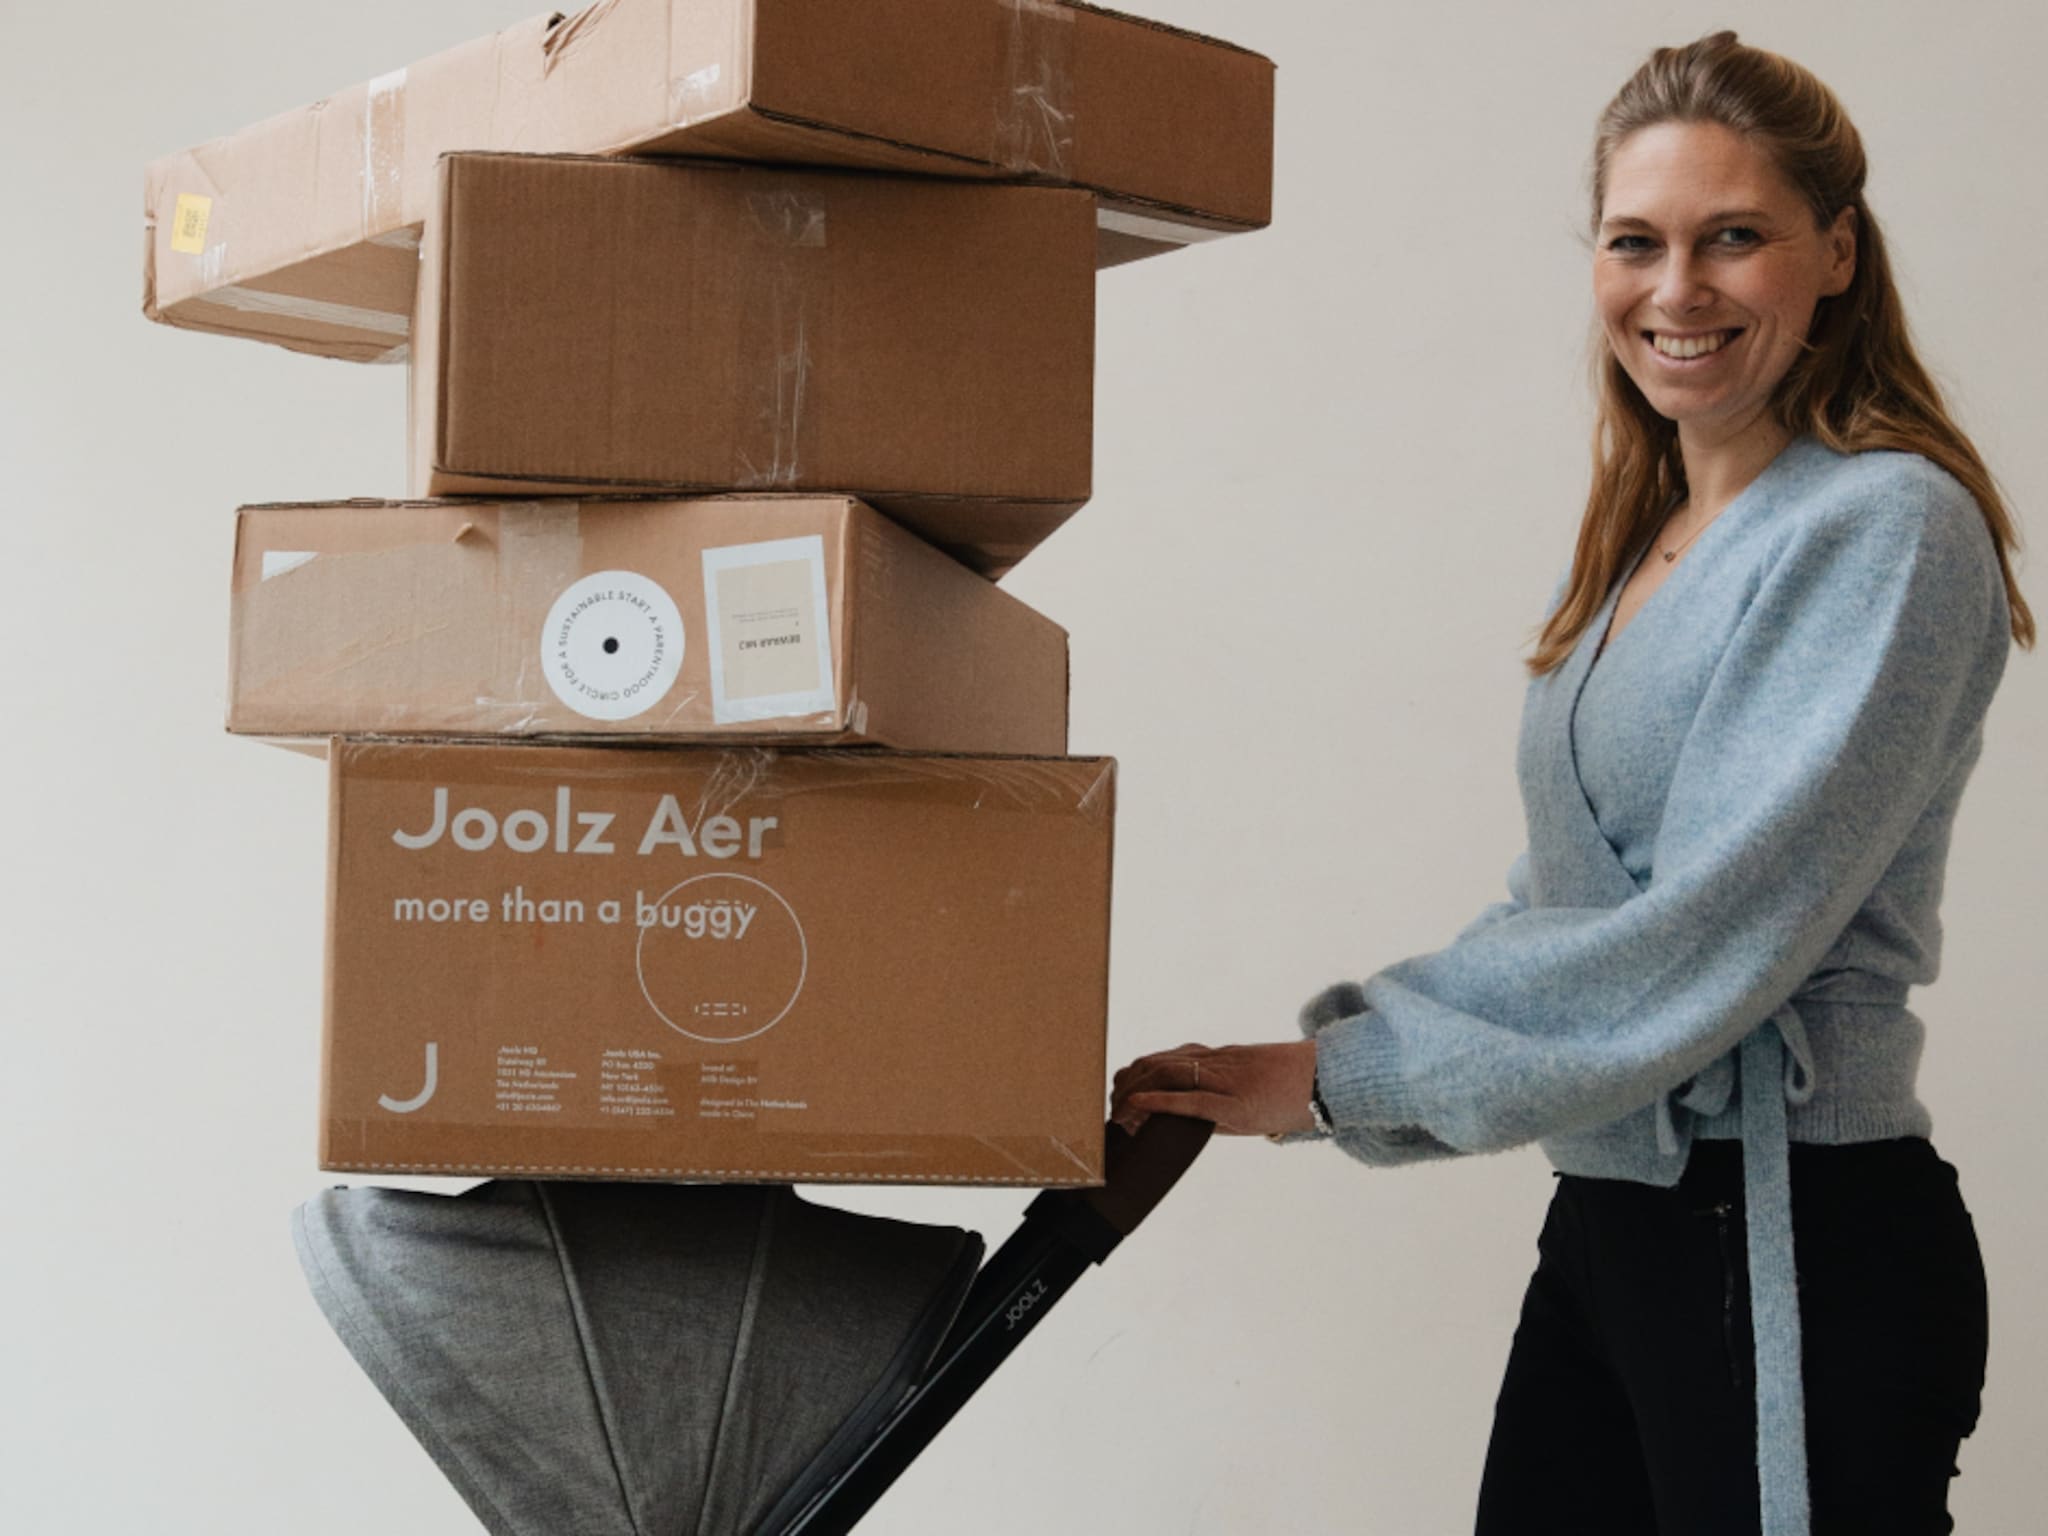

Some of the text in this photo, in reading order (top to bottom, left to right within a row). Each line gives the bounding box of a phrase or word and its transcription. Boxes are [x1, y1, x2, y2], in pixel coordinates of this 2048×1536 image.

[558, 590, 614, 647] SUSTAINABLE
[618, 591, 652, 614] START
[561, 662, 578, 685] FOR
[623, 625, 665, 698] PARENTHOOD
[579, 683, 621, 701] CIRCLE
[391, 785, 779, 859] Joolz Aer
[394, 885, 758, 940] more than a buggy
[378, 1042, 438, 1113] J
[1006, 1279, 1048, 1331] JOOLZ
